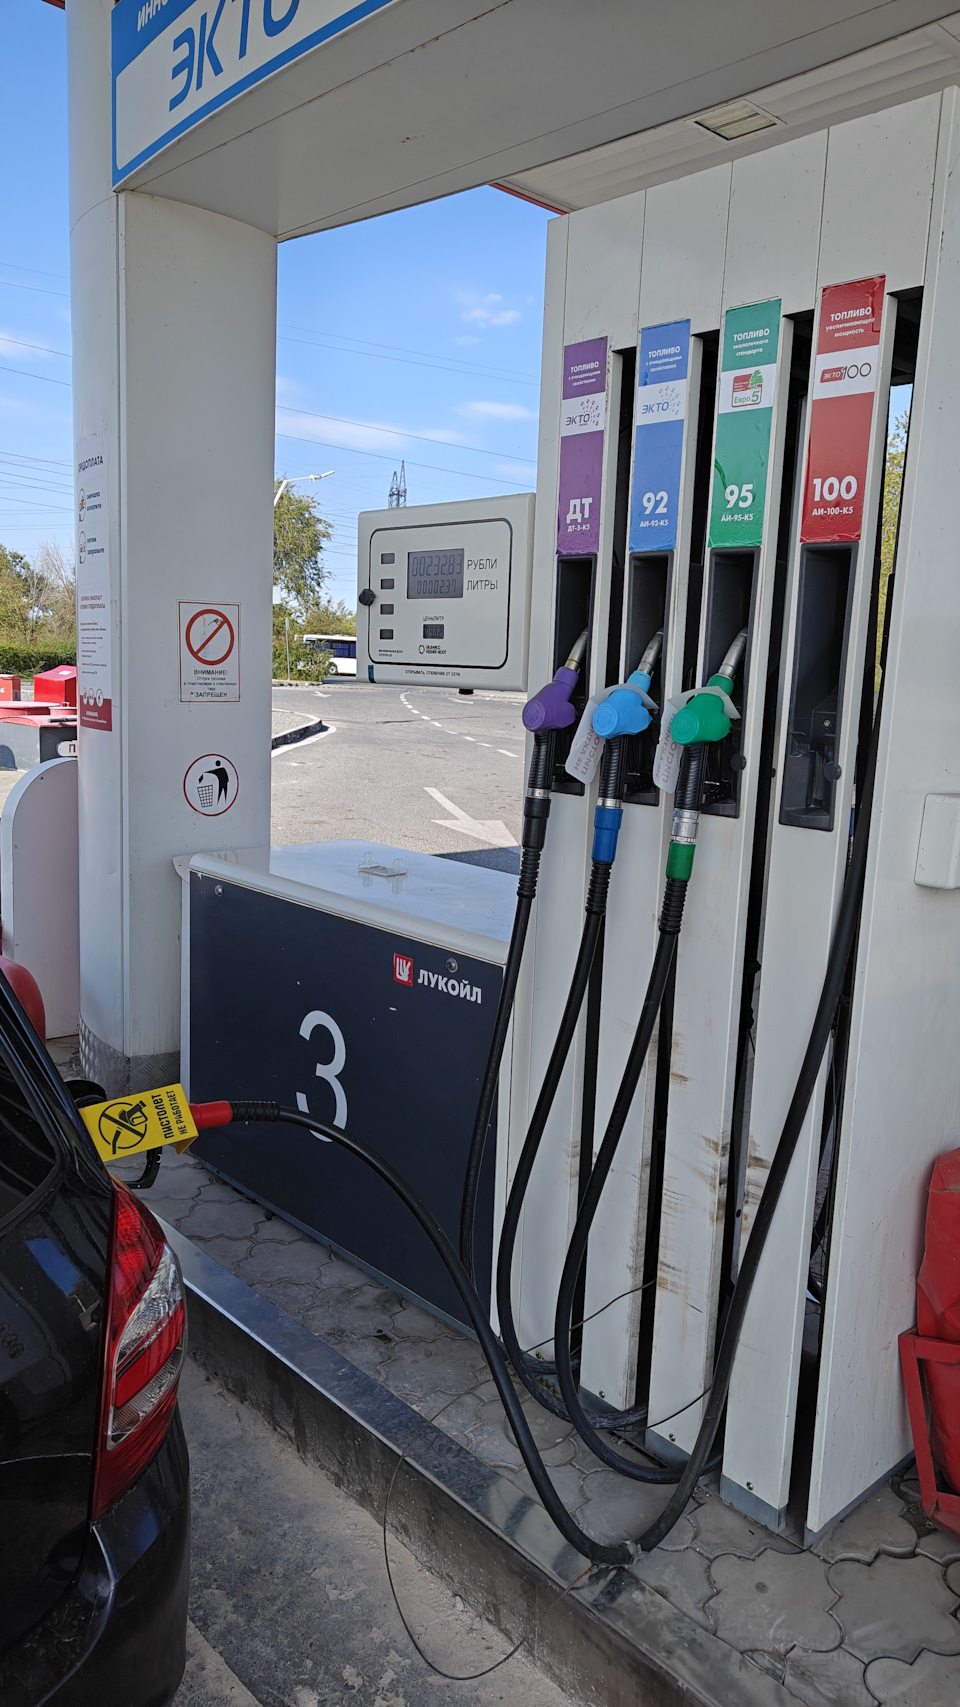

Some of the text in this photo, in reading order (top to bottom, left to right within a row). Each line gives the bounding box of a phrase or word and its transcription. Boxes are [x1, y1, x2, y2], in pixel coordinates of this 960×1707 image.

[830, 307, 872, 322] ТОПЛИВО
[733, 328, 770, 342] ТОПЛИВО
[834, 328, 864, 338] мощность
[648, 345, 681, 358] ТОПЛИВО
[570, 361, 600, 373] ТОПЛИВО
[823, 362, 872, 380] ЭКТО 100
[751, 390, 761, 403] 5
[642, 401, 670, 415] ЭКТО
[565, 413, 591, 427] ЭКТО
[813, 475, 858, 502] 100
[642, 491, 669, 515] 92
[724, 483, 754, 509] 95
[566, 497, 593, 524] ДТ
[721, 513, 754, 522] АИ-95-К5
[812, 506, 854, 516] АИ-100-К5
[640, 519, 669, 528] АИ-92-К5
[467, 558, 498, 570] РУБЛИ
[466, 579, 499, 591] ЛИТРЫ
[195, 691, 228, 699] ЗАПРЕЩЕН
[418, 969, 482, 1004] ЛУКОЙЛ
[296, 1010, 348, 1143] 3
[151, 1094, 175, 1139] ПИСТОЛЕТ
[166, 1090, 188, 1135] НЕ РАБОТАЕТ
